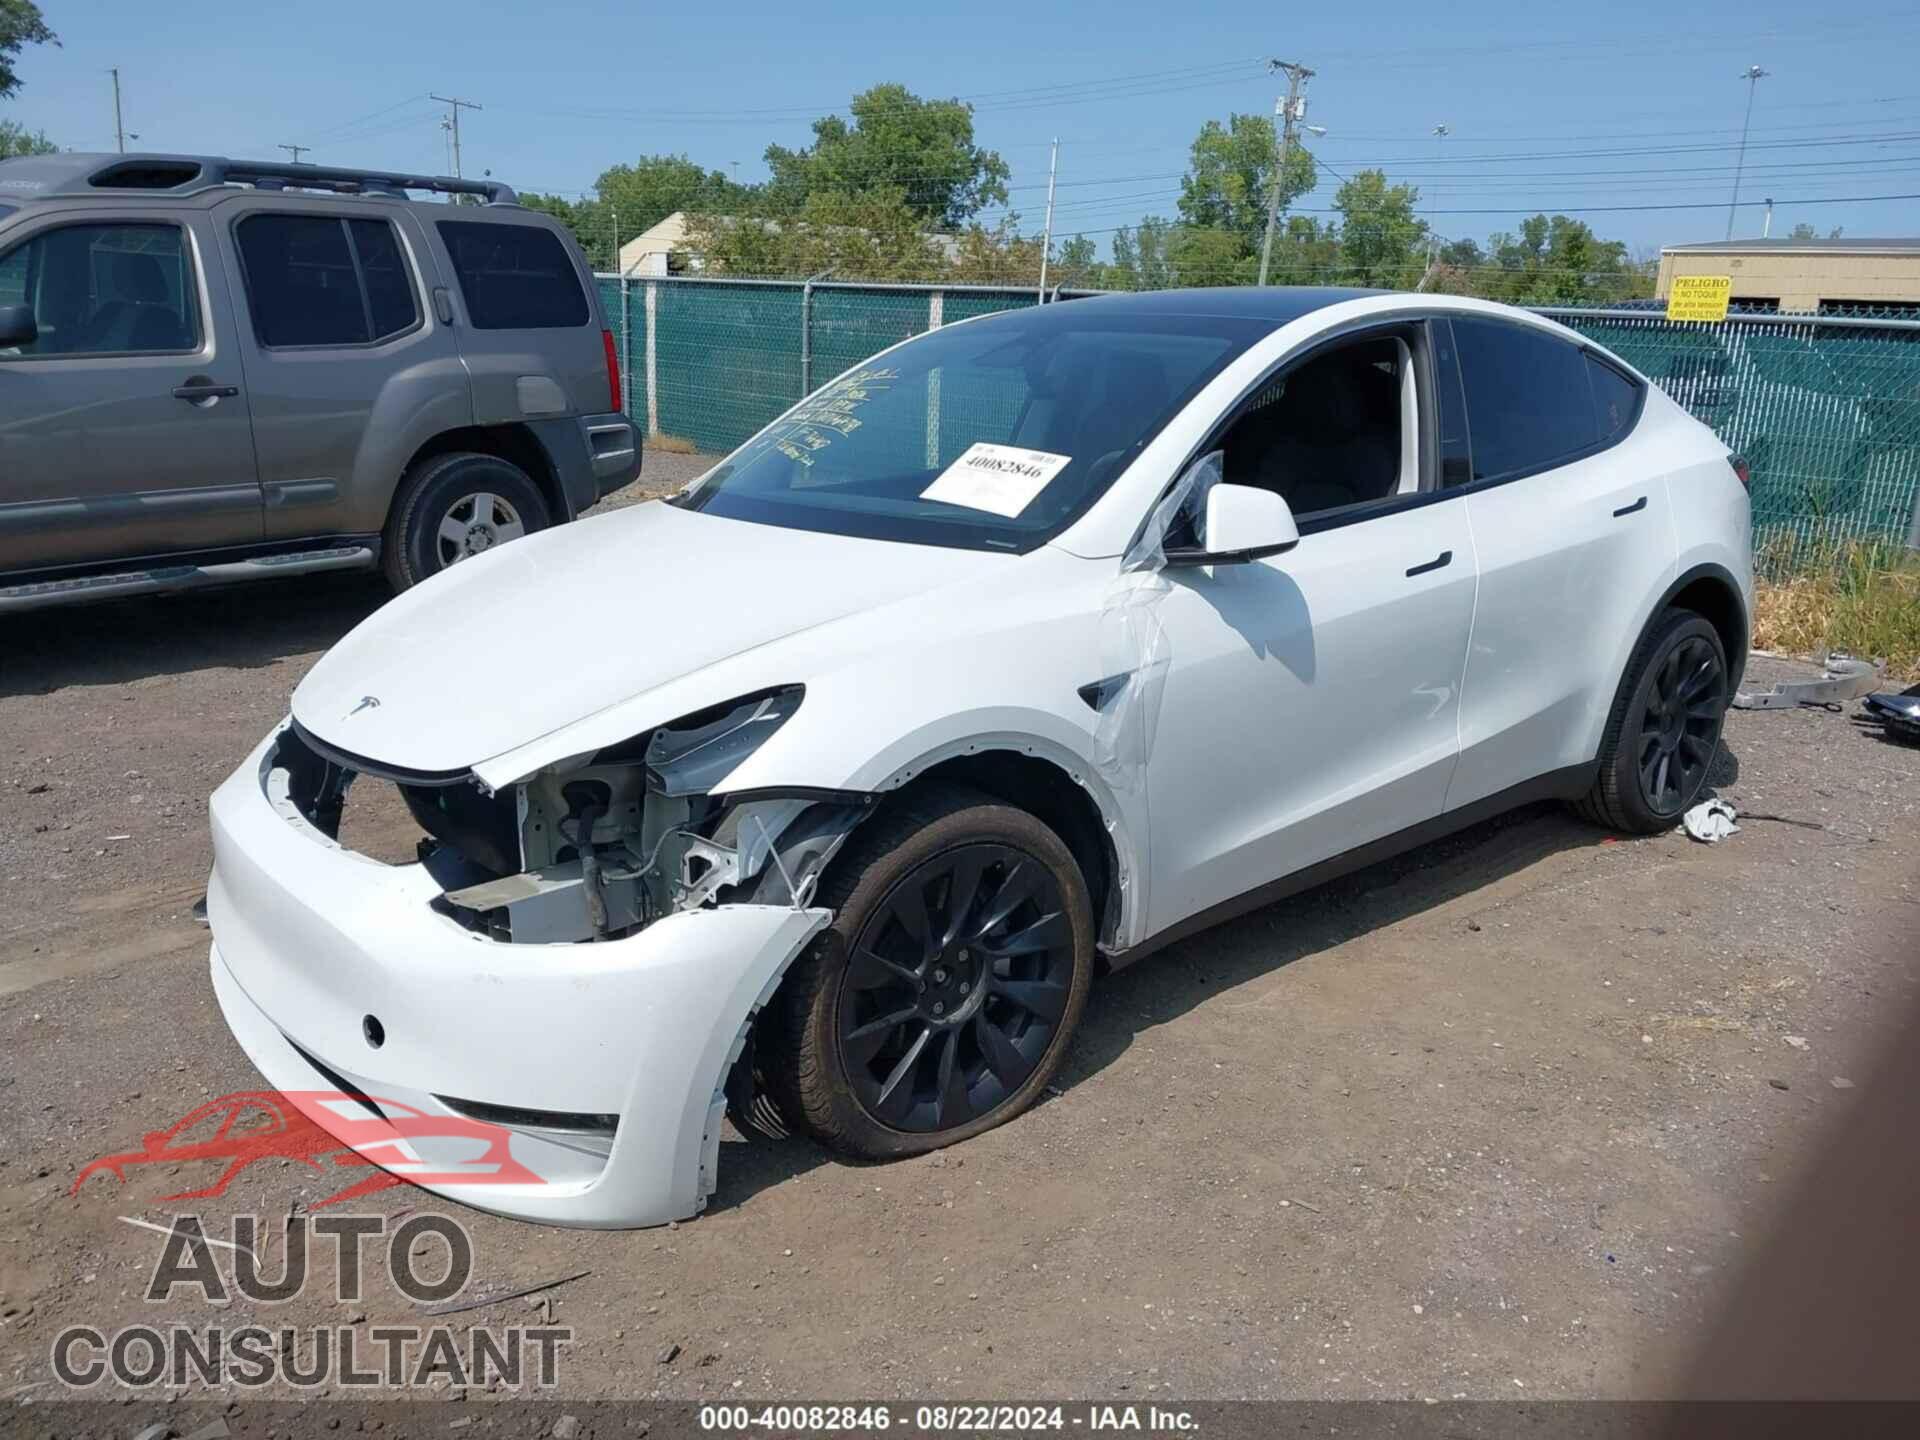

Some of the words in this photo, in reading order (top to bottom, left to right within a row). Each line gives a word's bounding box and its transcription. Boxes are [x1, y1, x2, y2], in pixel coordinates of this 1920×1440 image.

[1675, 279, 1729, 288] PELIGRO
[1694, 291, 1718, 299] TOQUE
[966, 455, 1042, 479] 40082846
